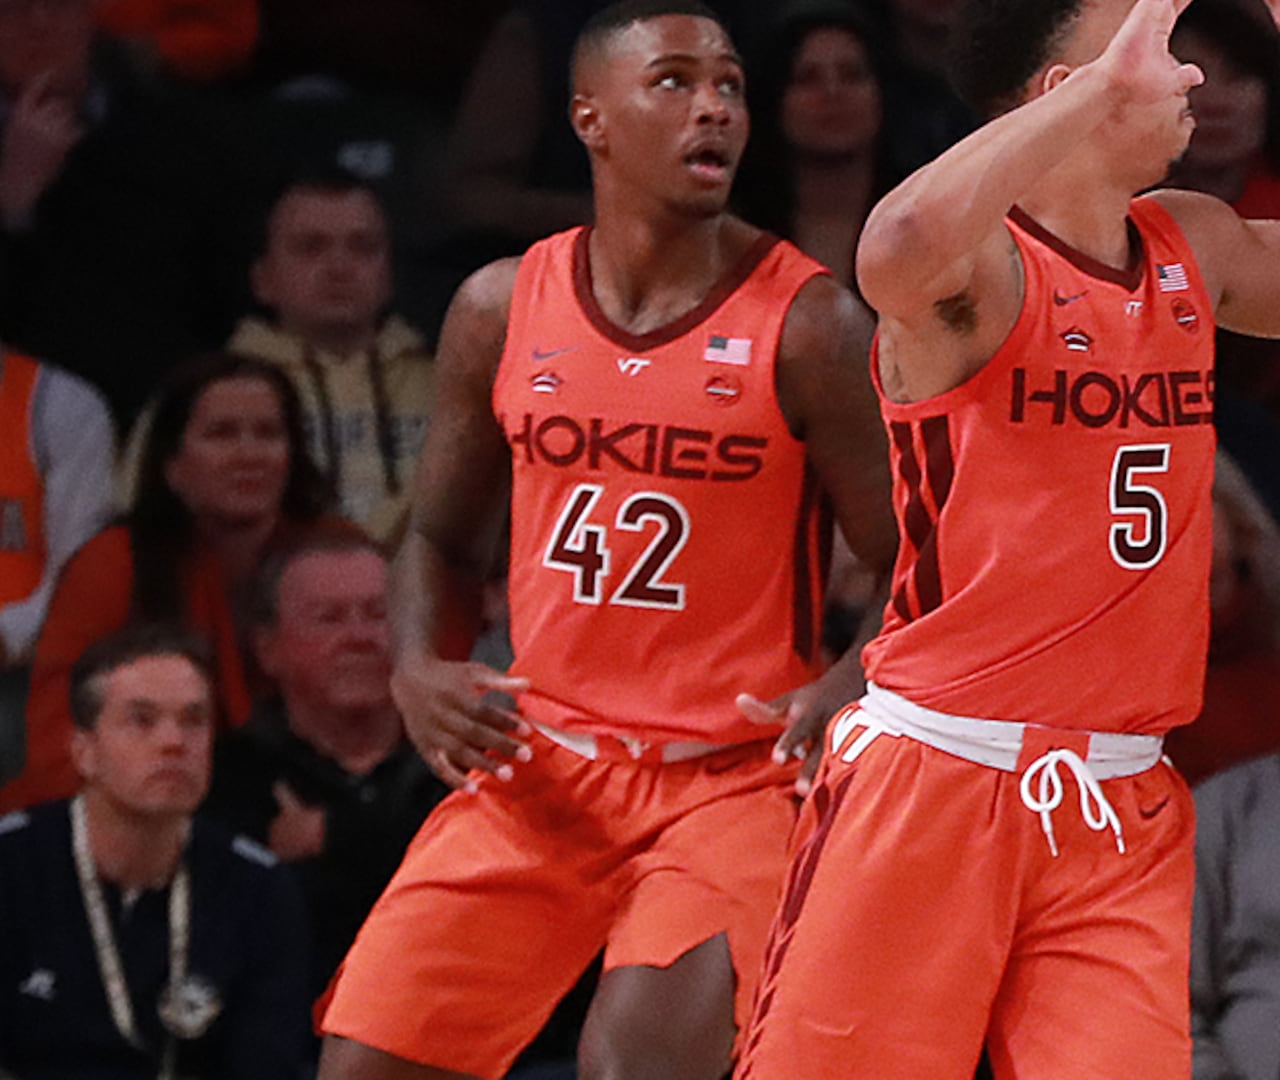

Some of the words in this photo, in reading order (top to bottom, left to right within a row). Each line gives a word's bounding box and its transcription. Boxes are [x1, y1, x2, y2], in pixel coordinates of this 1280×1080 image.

[617, 357, 652, 376] VT
[541, 483, 691, 611] 42
[1108, 443, 1172, 570] 5
